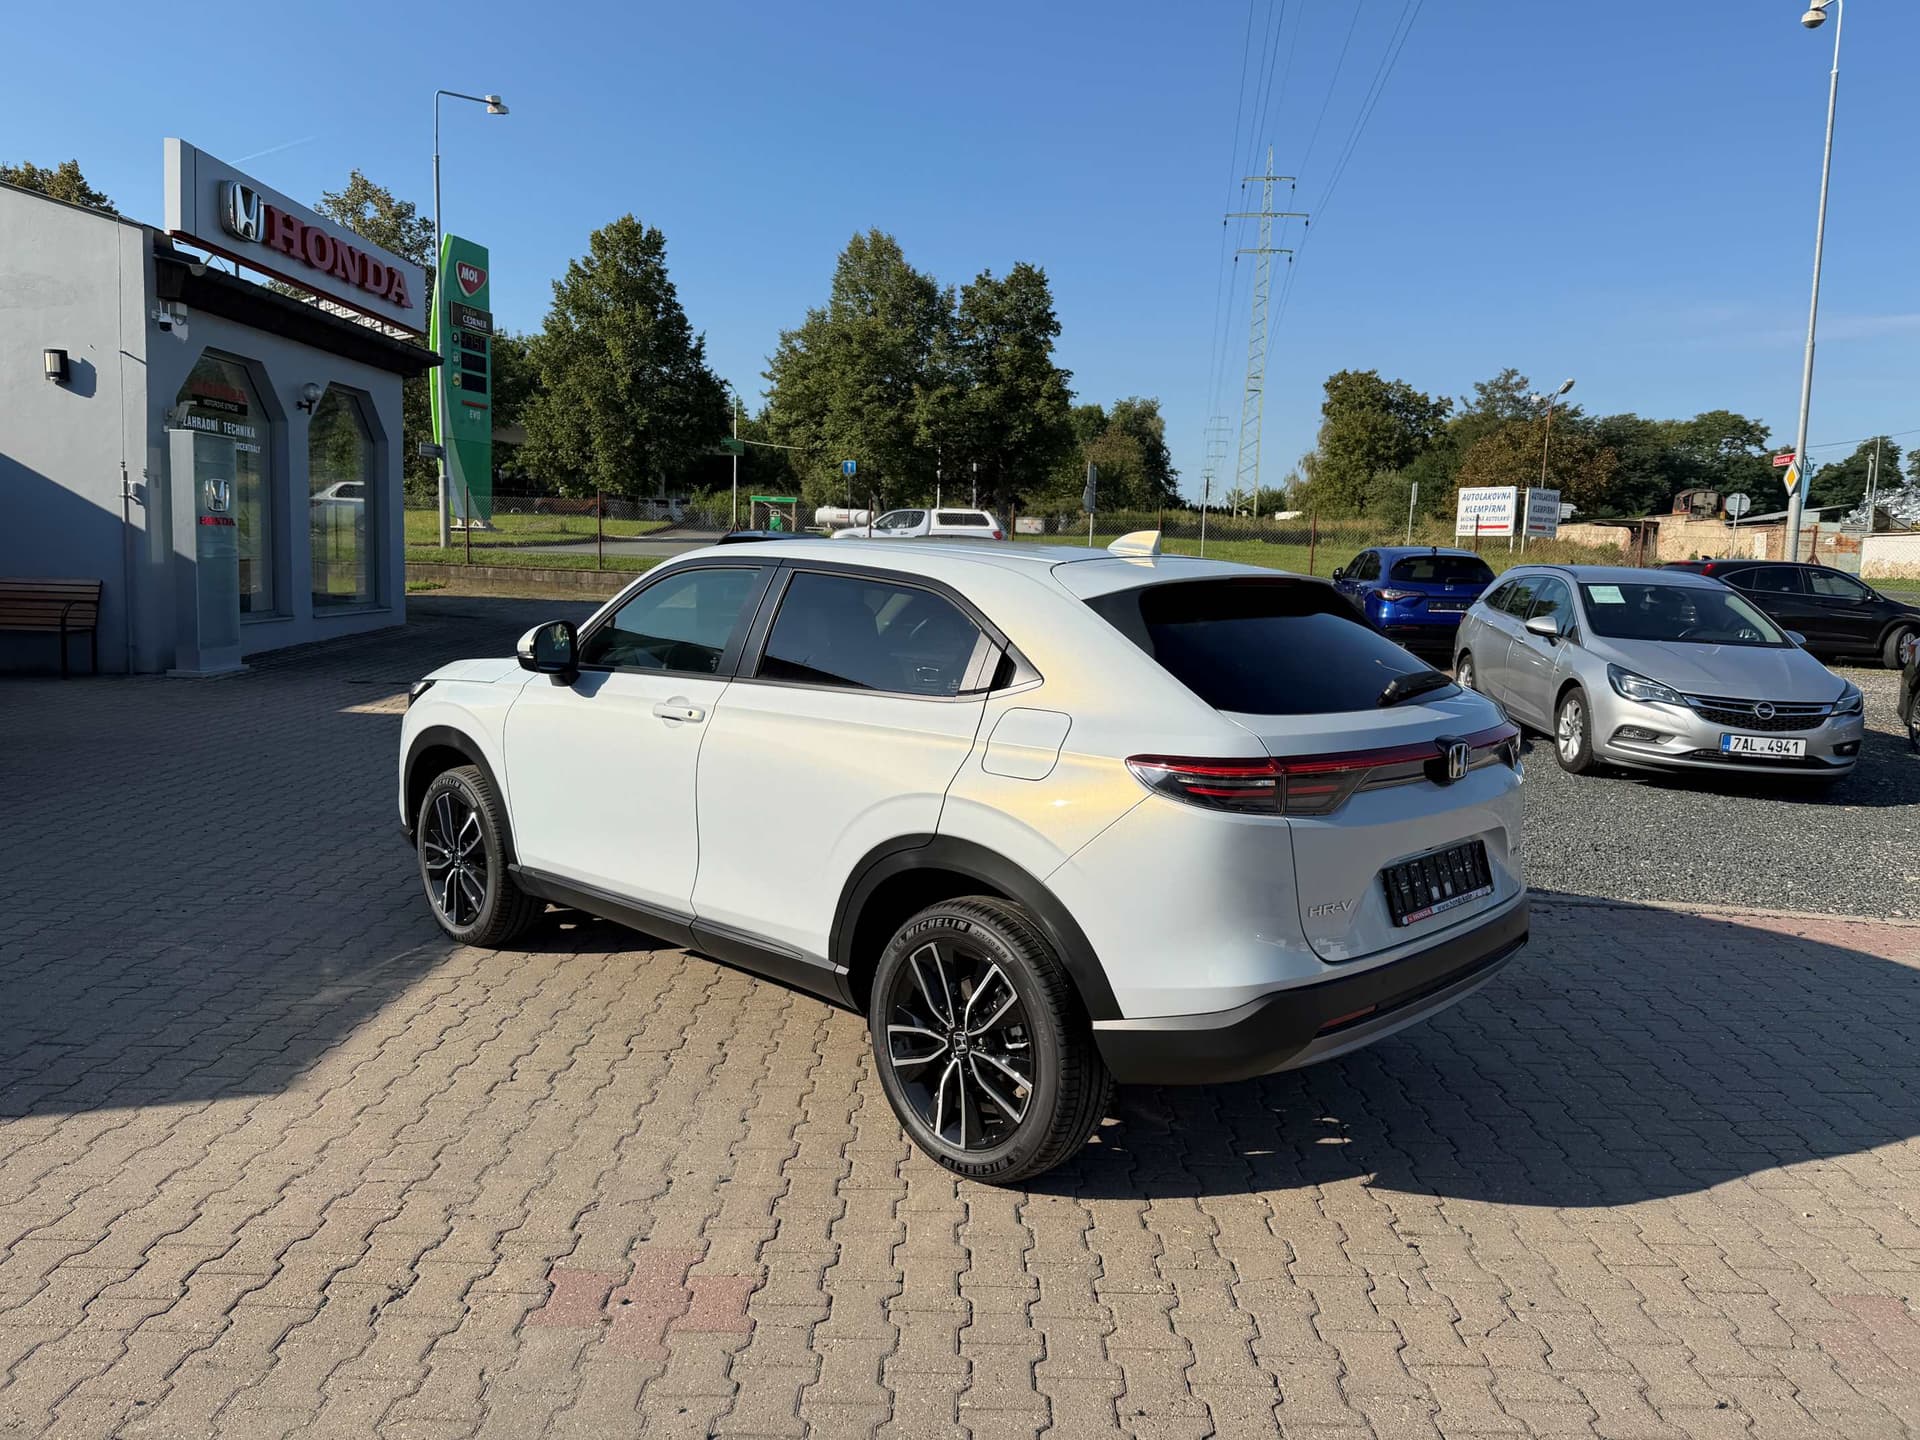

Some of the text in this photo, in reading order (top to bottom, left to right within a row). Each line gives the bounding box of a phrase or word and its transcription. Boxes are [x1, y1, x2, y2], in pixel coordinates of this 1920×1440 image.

[265, 205, 414, 309] HONDA
[461, 266, 479, 283] MOL
[463, 315, 487, 328] CORNER
[183, 415, 256, 439] ZAHRADNÍ TECHNIKA
[1462, 492, 1511, 501] AUTOLAKOVNA
[1465, 504, 1506, 513] KLEMPÍRNA
[1733, 737, 1757, 751] 7AL
[1767, 740, 1799, 754] 4941
[1308, 898, 1353, 918] HR-V
[905, 919, 968, 939] MICHELIN
